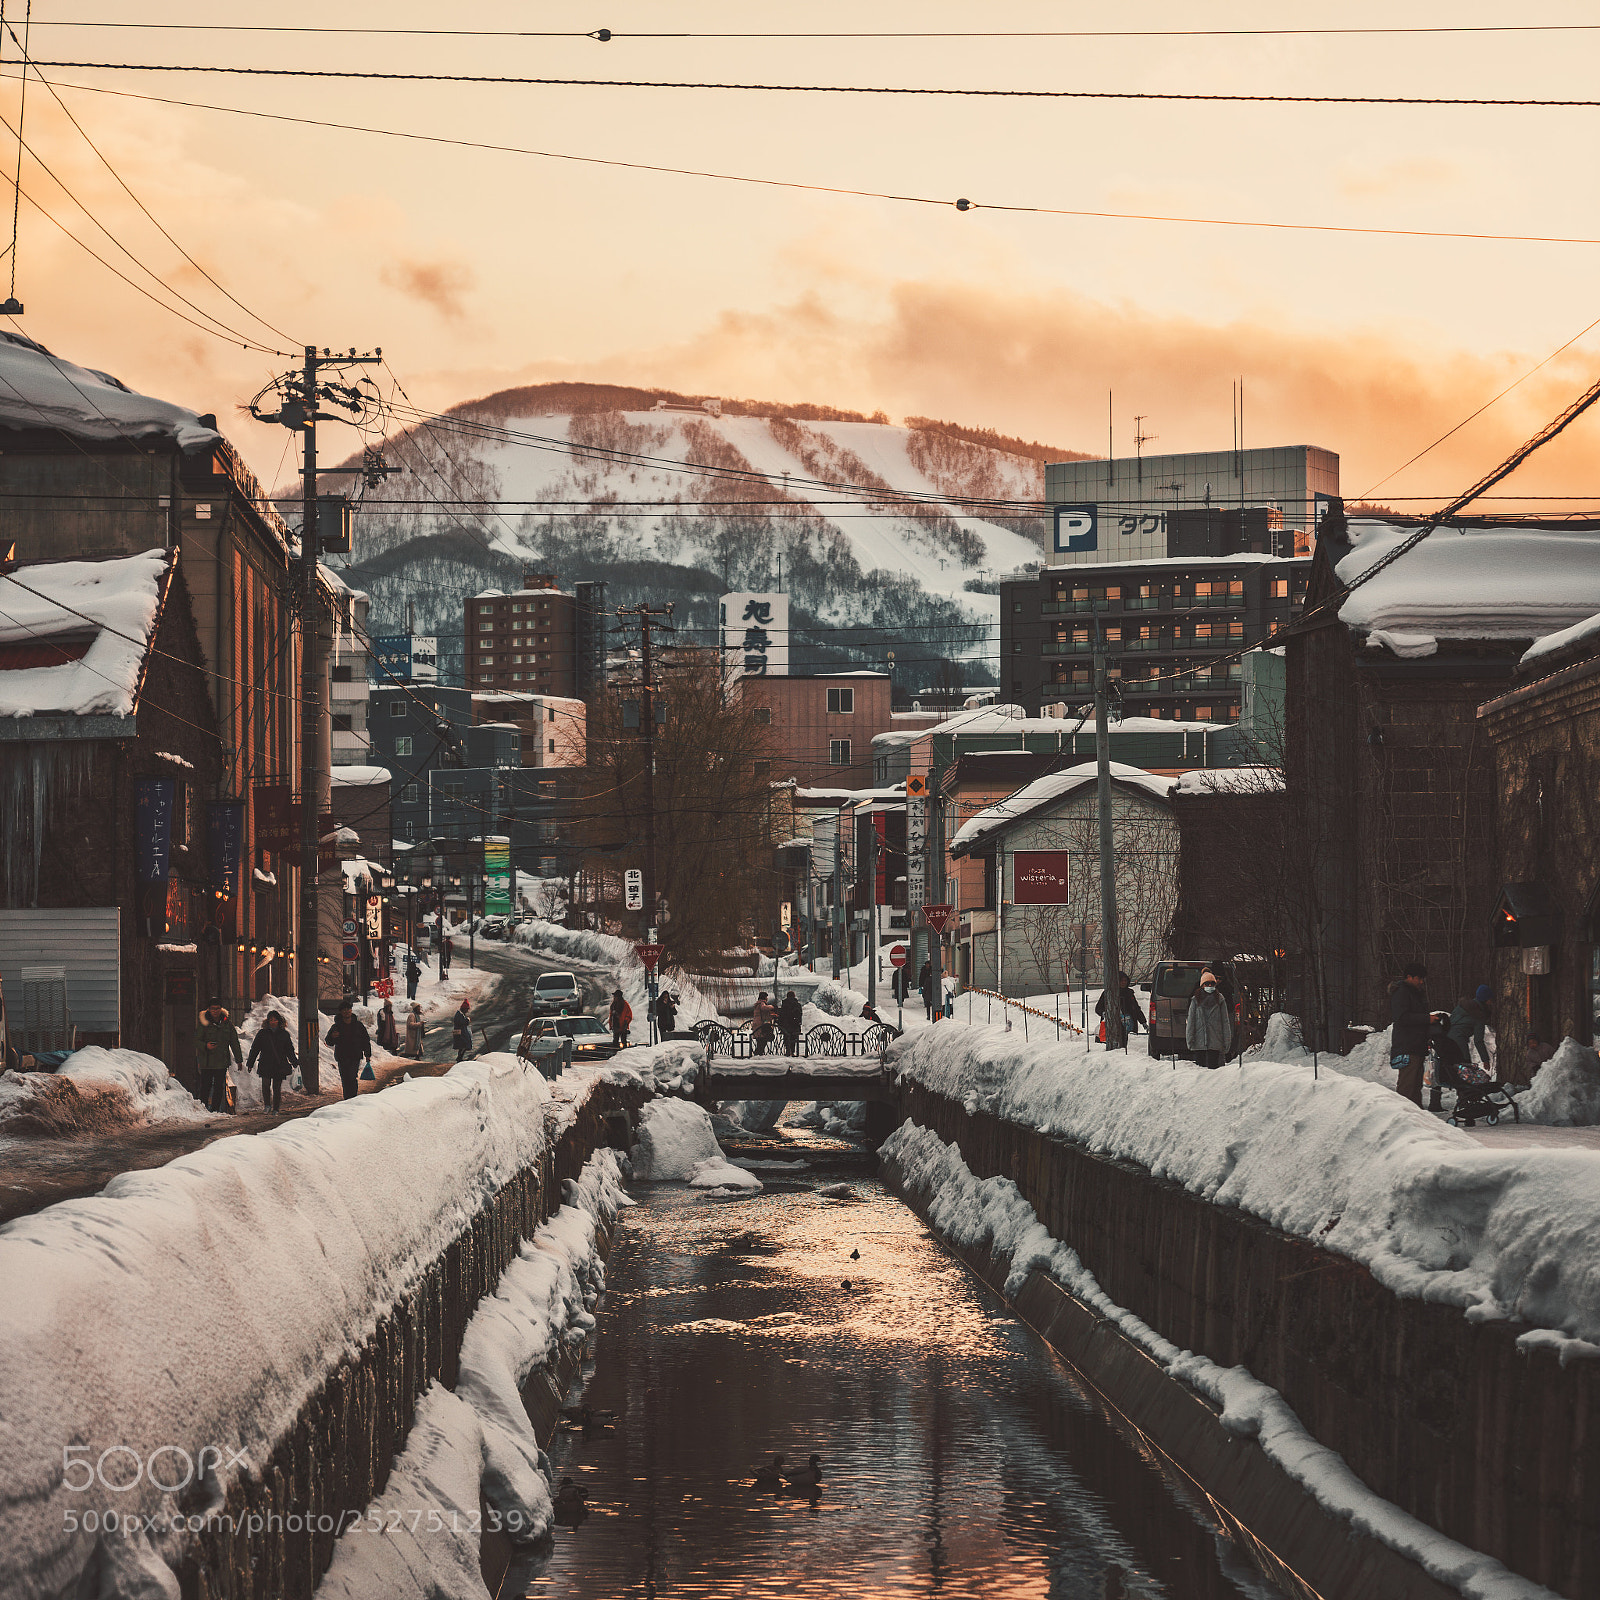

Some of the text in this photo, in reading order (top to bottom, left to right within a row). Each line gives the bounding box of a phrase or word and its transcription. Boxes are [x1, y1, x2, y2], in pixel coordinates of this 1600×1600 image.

[1058, 511, 1092, 547] P
[742, 599, 774, 675] 旭寿司
[627, 870, 640, 901] 北一硝子
[1019, 873, 1057, 882] wisteria
[928, 909, 949, 918] 止まれ
[343, 922, 355, 932] 30
